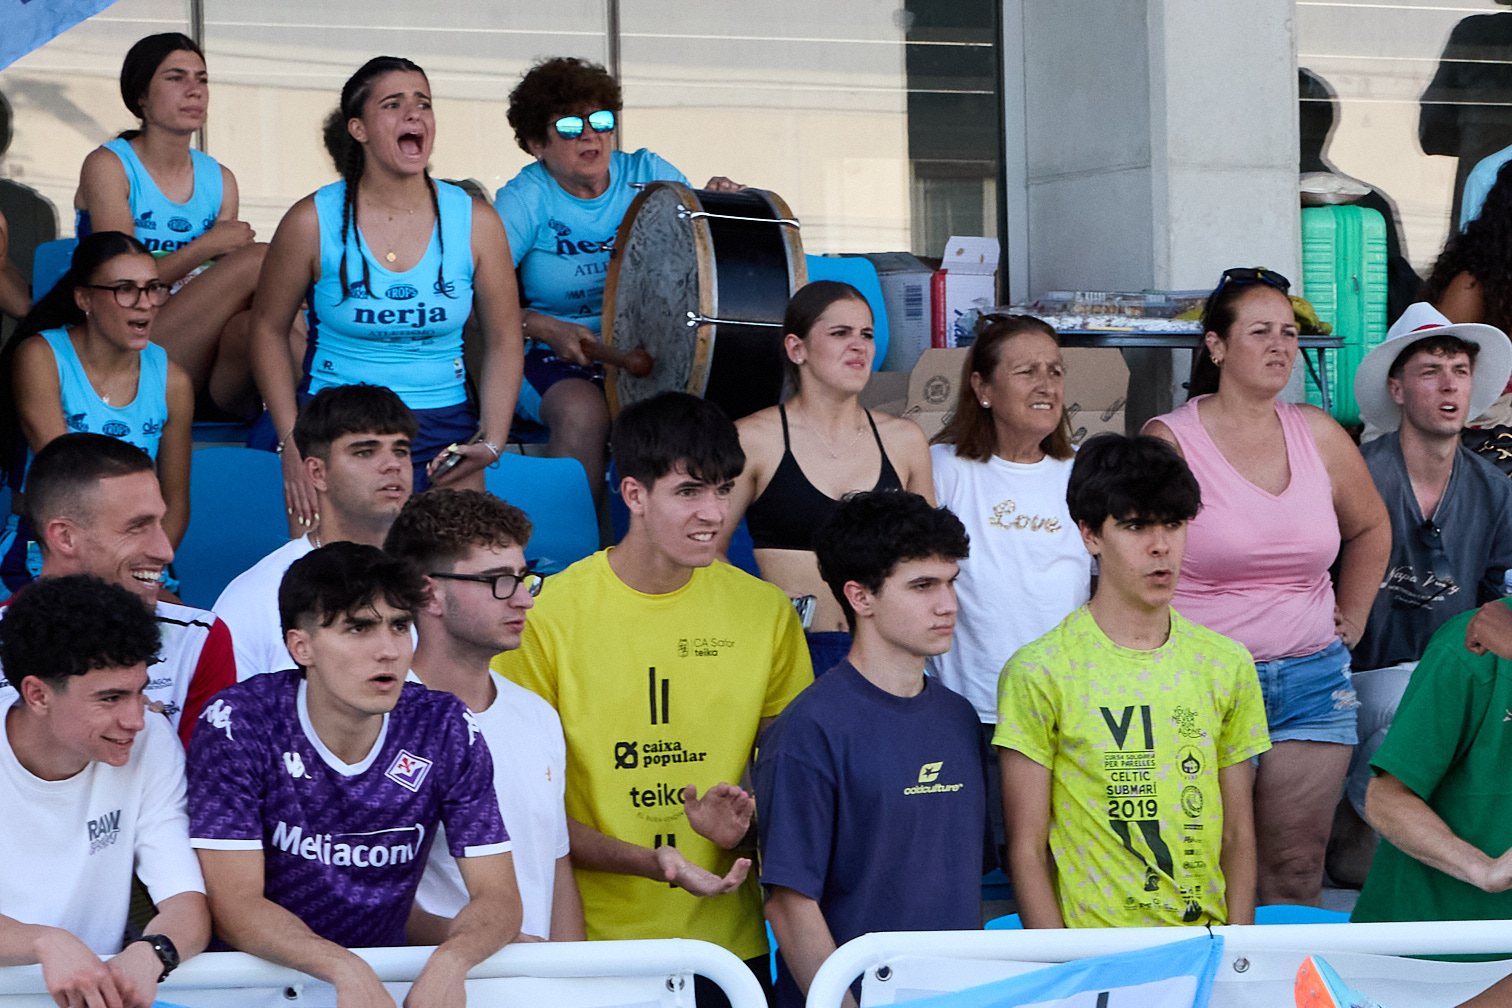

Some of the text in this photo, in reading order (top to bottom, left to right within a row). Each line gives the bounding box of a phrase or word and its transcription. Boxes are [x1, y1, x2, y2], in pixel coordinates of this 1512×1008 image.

[555, 236, 614, 255] ner
[353, 302, 448, 328] nerja
[989, 500, 1062, 533] Love
[1099, 705, 1154, 750] VI
[642, 740, 682, 753] caixa
[643, 750, 707, 768] popular
[1111, 772, 1151, 781] CELTIC
[1108, 799, 1158, 818] 2019
[87, 809, 121, 841] RAW
